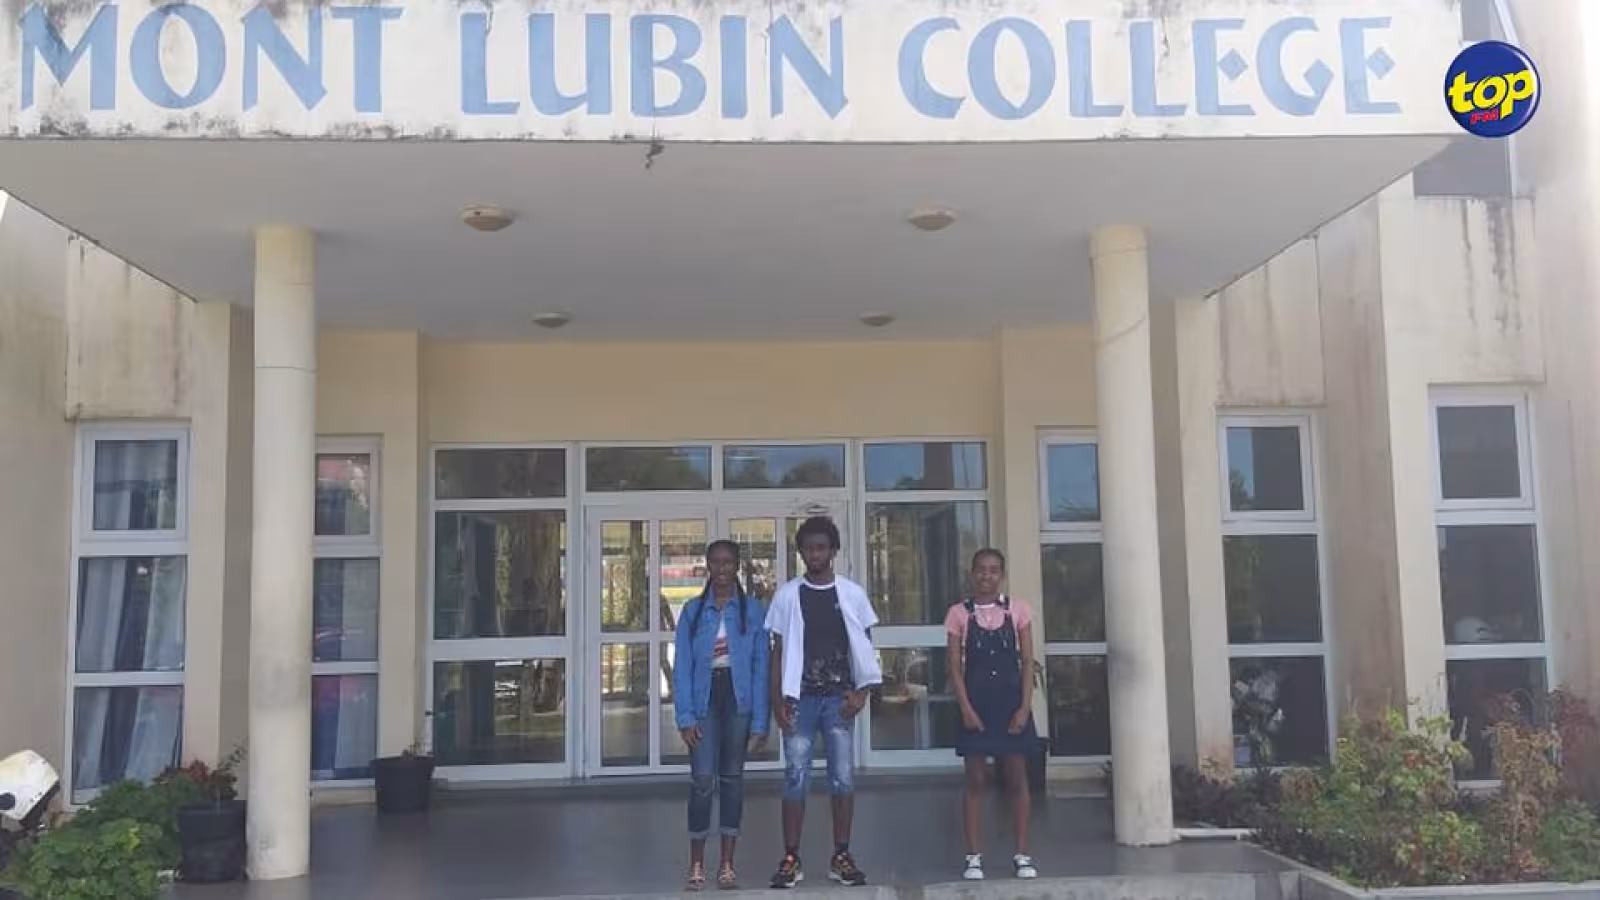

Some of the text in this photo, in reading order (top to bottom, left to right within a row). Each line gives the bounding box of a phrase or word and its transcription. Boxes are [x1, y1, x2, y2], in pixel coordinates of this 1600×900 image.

[20, 3, 1401, 119] MONT LUBIN COLLEGE
